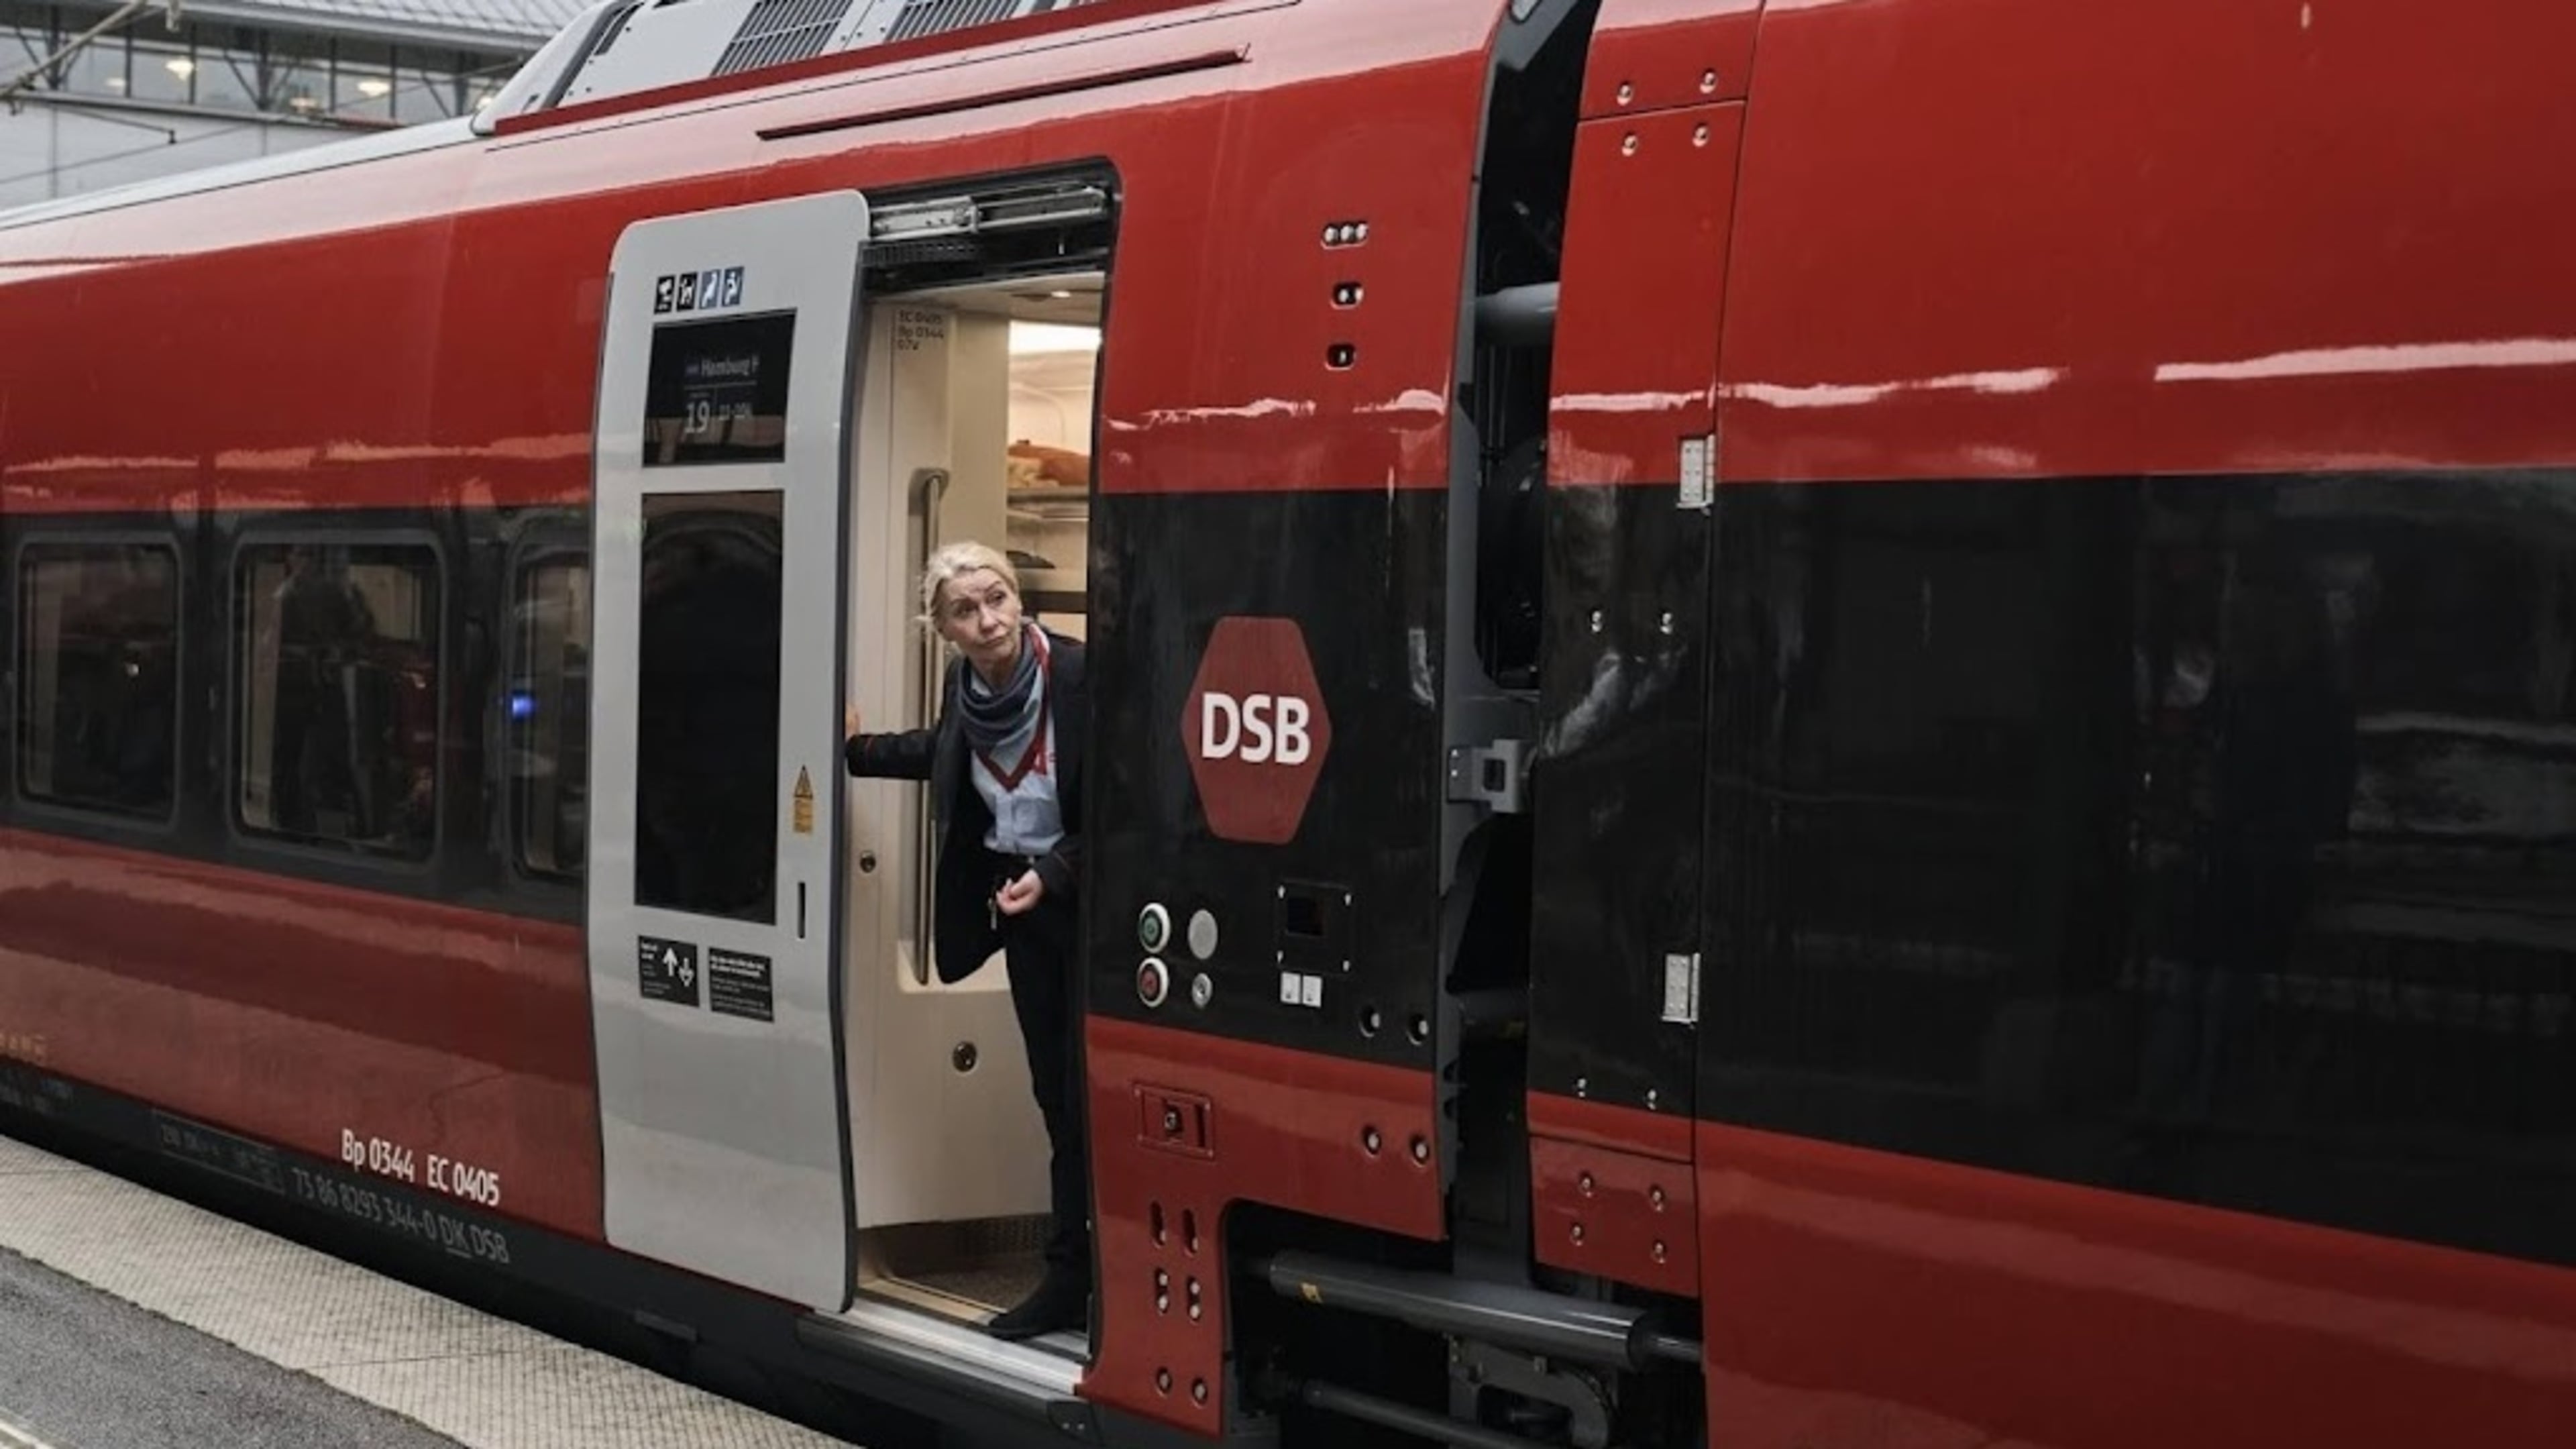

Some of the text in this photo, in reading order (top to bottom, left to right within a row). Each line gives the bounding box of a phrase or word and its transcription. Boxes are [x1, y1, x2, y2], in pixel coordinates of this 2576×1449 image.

[701, 356, 750, 377] Hamburg
[685, 400, 710, 433] 19
[1201, 692, 1310, 765] DSB
[341, 1128, 500, 1206] Bp 0344 EC 0405
[291, 1167, 315, 1199] 73
[316, 1175, 338, 1208] 86
[339, 1182, 382, 1223] 8293
[382, 1196, 437, 1241] 344-0
[438, 1214, 470, 1252] DK
[469, 1223, 511, 1264] DSB
